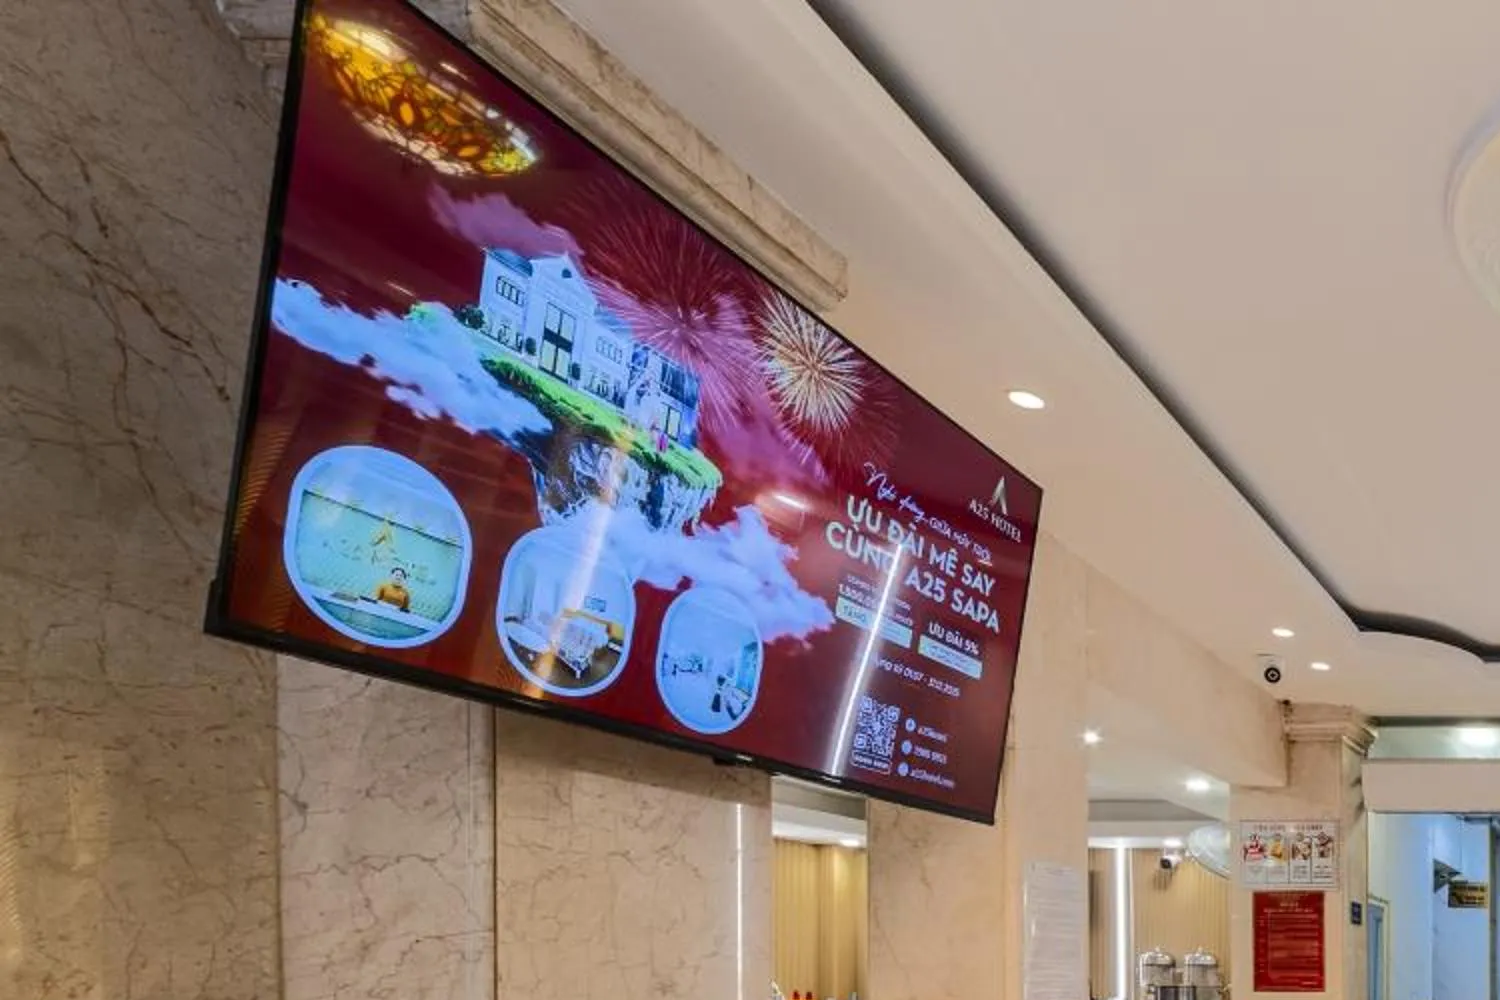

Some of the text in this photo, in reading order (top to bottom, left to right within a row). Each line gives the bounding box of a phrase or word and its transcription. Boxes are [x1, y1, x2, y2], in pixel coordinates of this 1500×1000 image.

[846, 493, 997, 599] ƯU ĐÃI MÊ SAY
[969, 498, 1021, 543] A25 HOTEL
[904, 565, 947, 603] A25
[950, 587, 1000, 636] SAPA
[928, 620, 946, 639] ƯU
